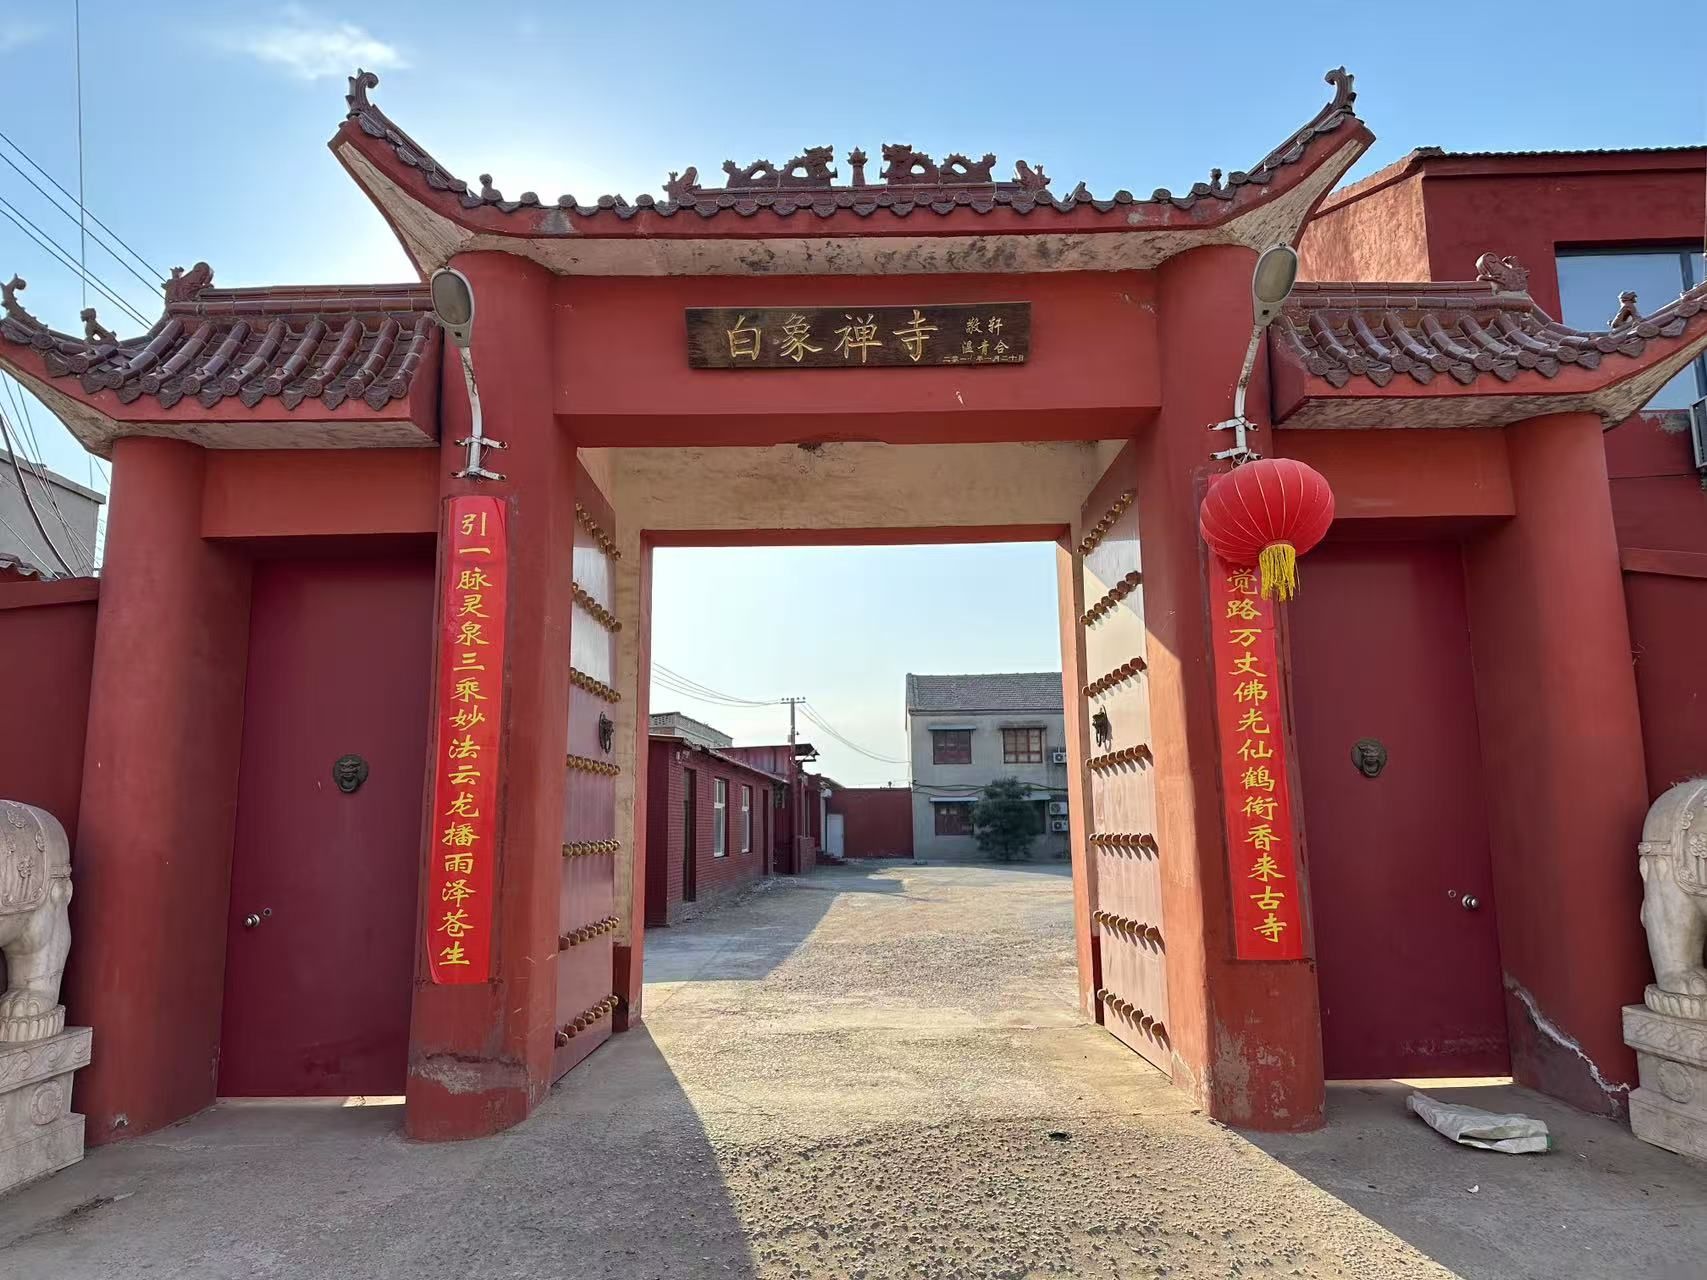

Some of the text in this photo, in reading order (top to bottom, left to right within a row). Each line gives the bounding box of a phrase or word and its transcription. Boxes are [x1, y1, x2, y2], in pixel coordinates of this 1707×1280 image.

[726, 309, 939, 362] 白象禅寺
[437, 511, 493, 966] 引一脉灵泉三乘妙法云龙播雨泽苍生
